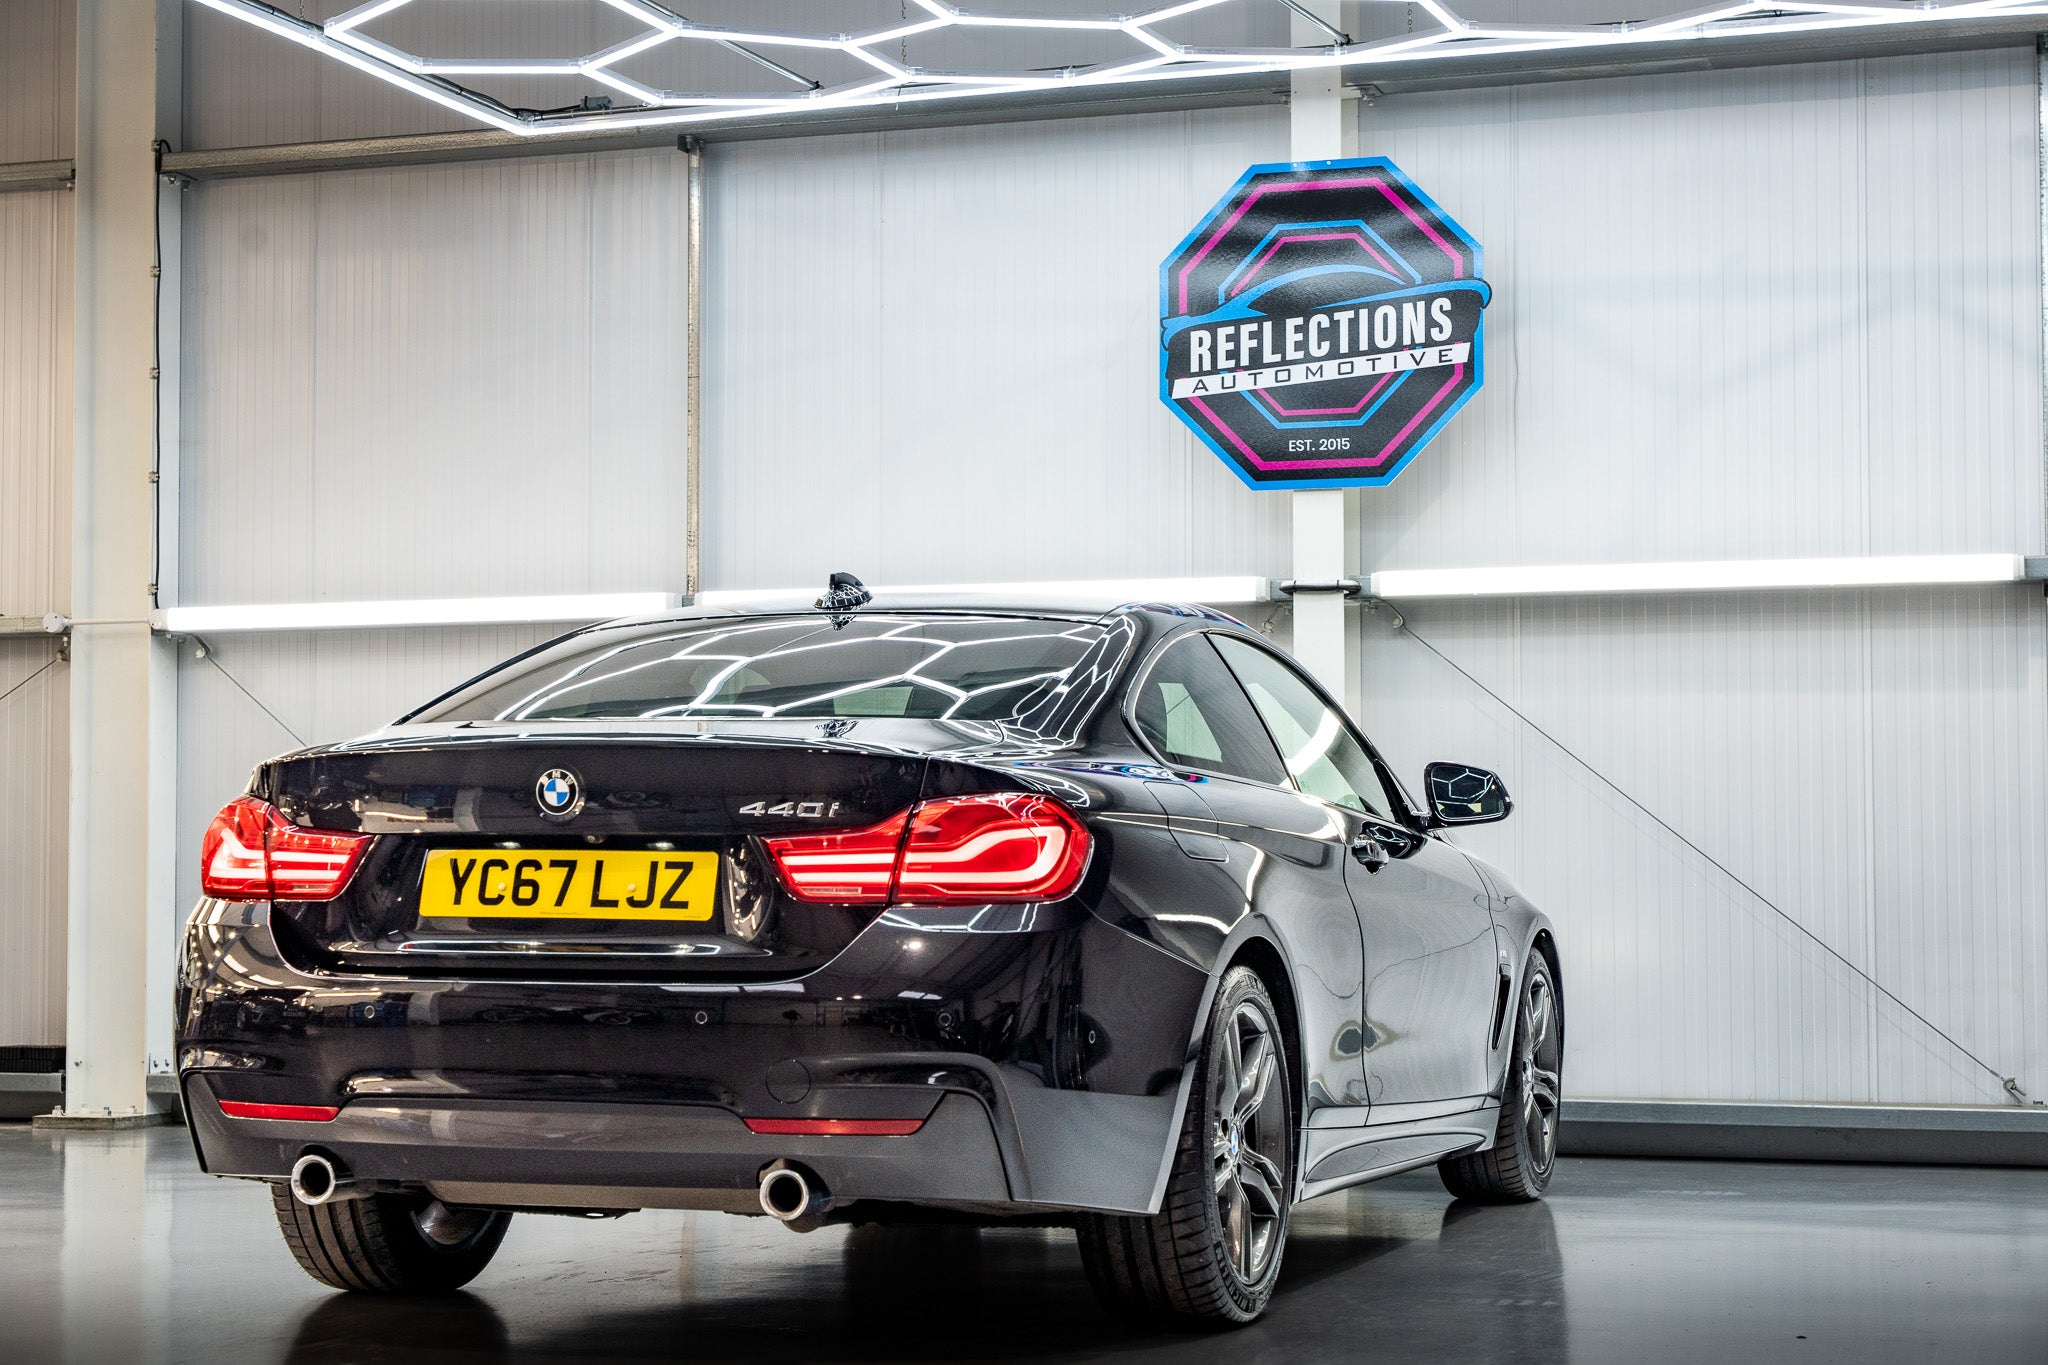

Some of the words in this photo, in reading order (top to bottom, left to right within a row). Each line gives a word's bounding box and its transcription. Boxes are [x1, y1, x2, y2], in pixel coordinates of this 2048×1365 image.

[1189, 297, 1453, 373] REFLECTIONS
[1191, 348, 1454, 394] AUTOMOTIVE
[1288, 439, 1316, 452] EST.
[1319, 437, 1351, 451] 2015
[739, 801, 840, 818] 440i
[450, 857, 578, 907] YC67
[590, 859, 695, 910] LJZ
[1214, 1245, 1249, 1311] MICHELIN
